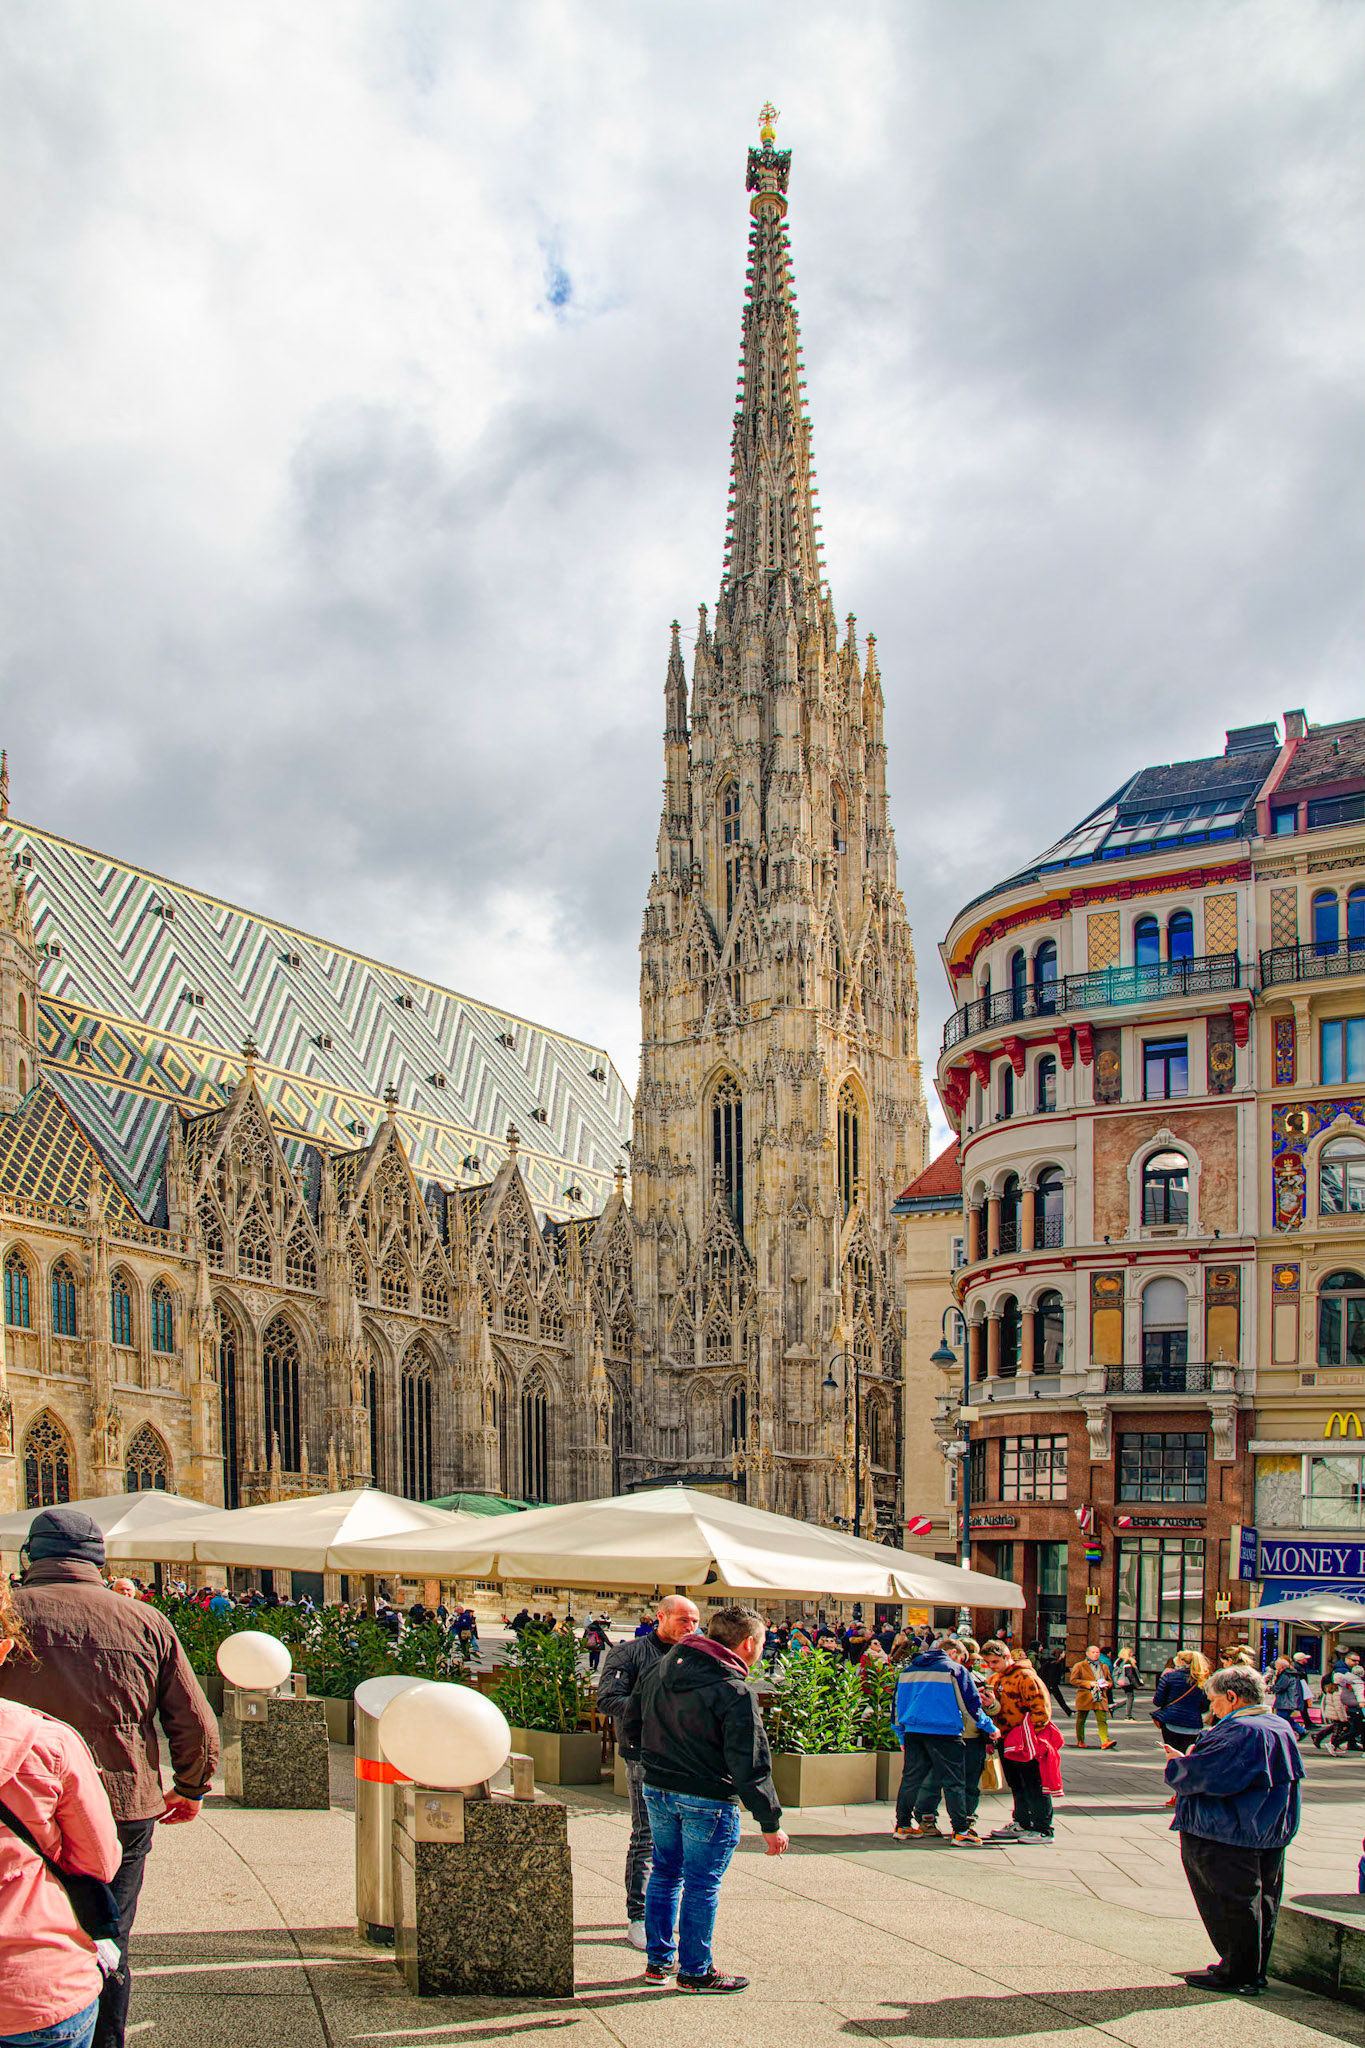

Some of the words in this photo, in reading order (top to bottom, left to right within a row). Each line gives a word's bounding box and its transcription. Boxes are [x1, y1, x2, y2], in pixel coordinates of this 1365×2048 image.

[984, 1513, 1016, 1526] Austria
[1132, 1517, 1160, 1527] Bank
[1163, 1518, 1202, 1528] Austria
[1240, 1546, 1256, 1561] CHANGE
[1261, 1546, 1352, 1574] MONEY
